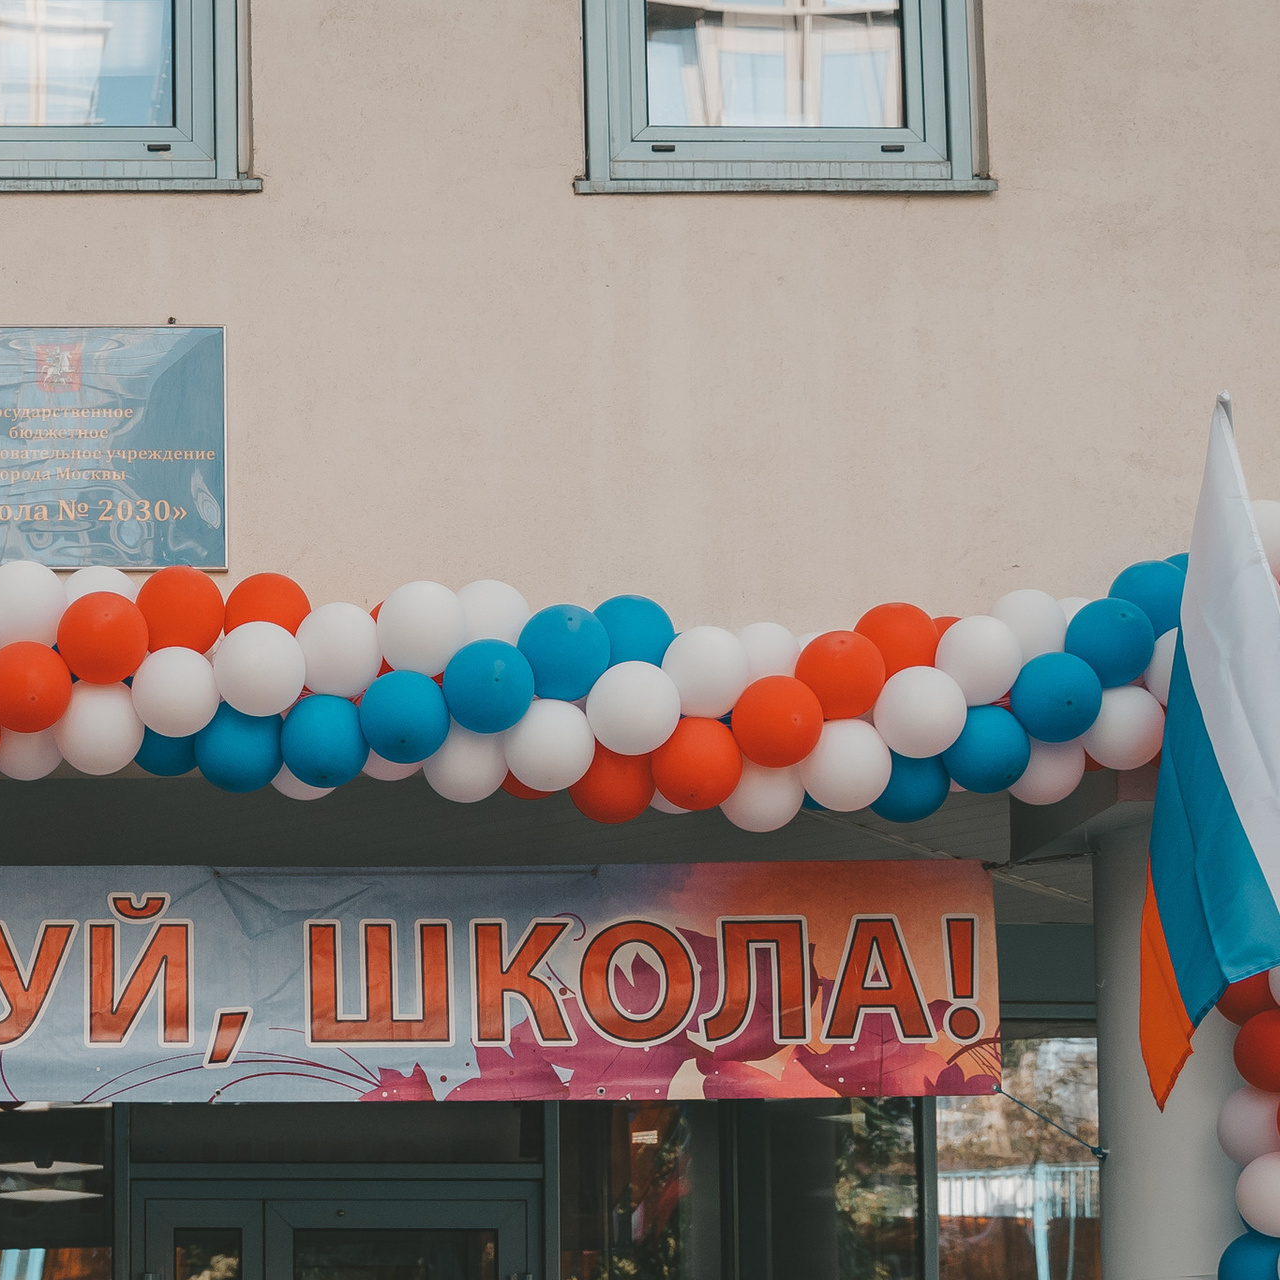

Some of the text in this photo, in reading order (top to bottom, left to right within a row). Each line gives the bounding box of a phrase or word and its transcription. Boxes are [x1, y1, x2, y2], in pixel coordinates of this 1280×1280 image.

[8, 425, 109, 441] бюджетное
[106, 448, 216, 464] учреждение
[56, 467, 127, 481] Москвы
[57, 499, 90, 522] №
[97, 499, 188, 522] 2030»
[305, 915, 984, 1047] ШКОЛА!
